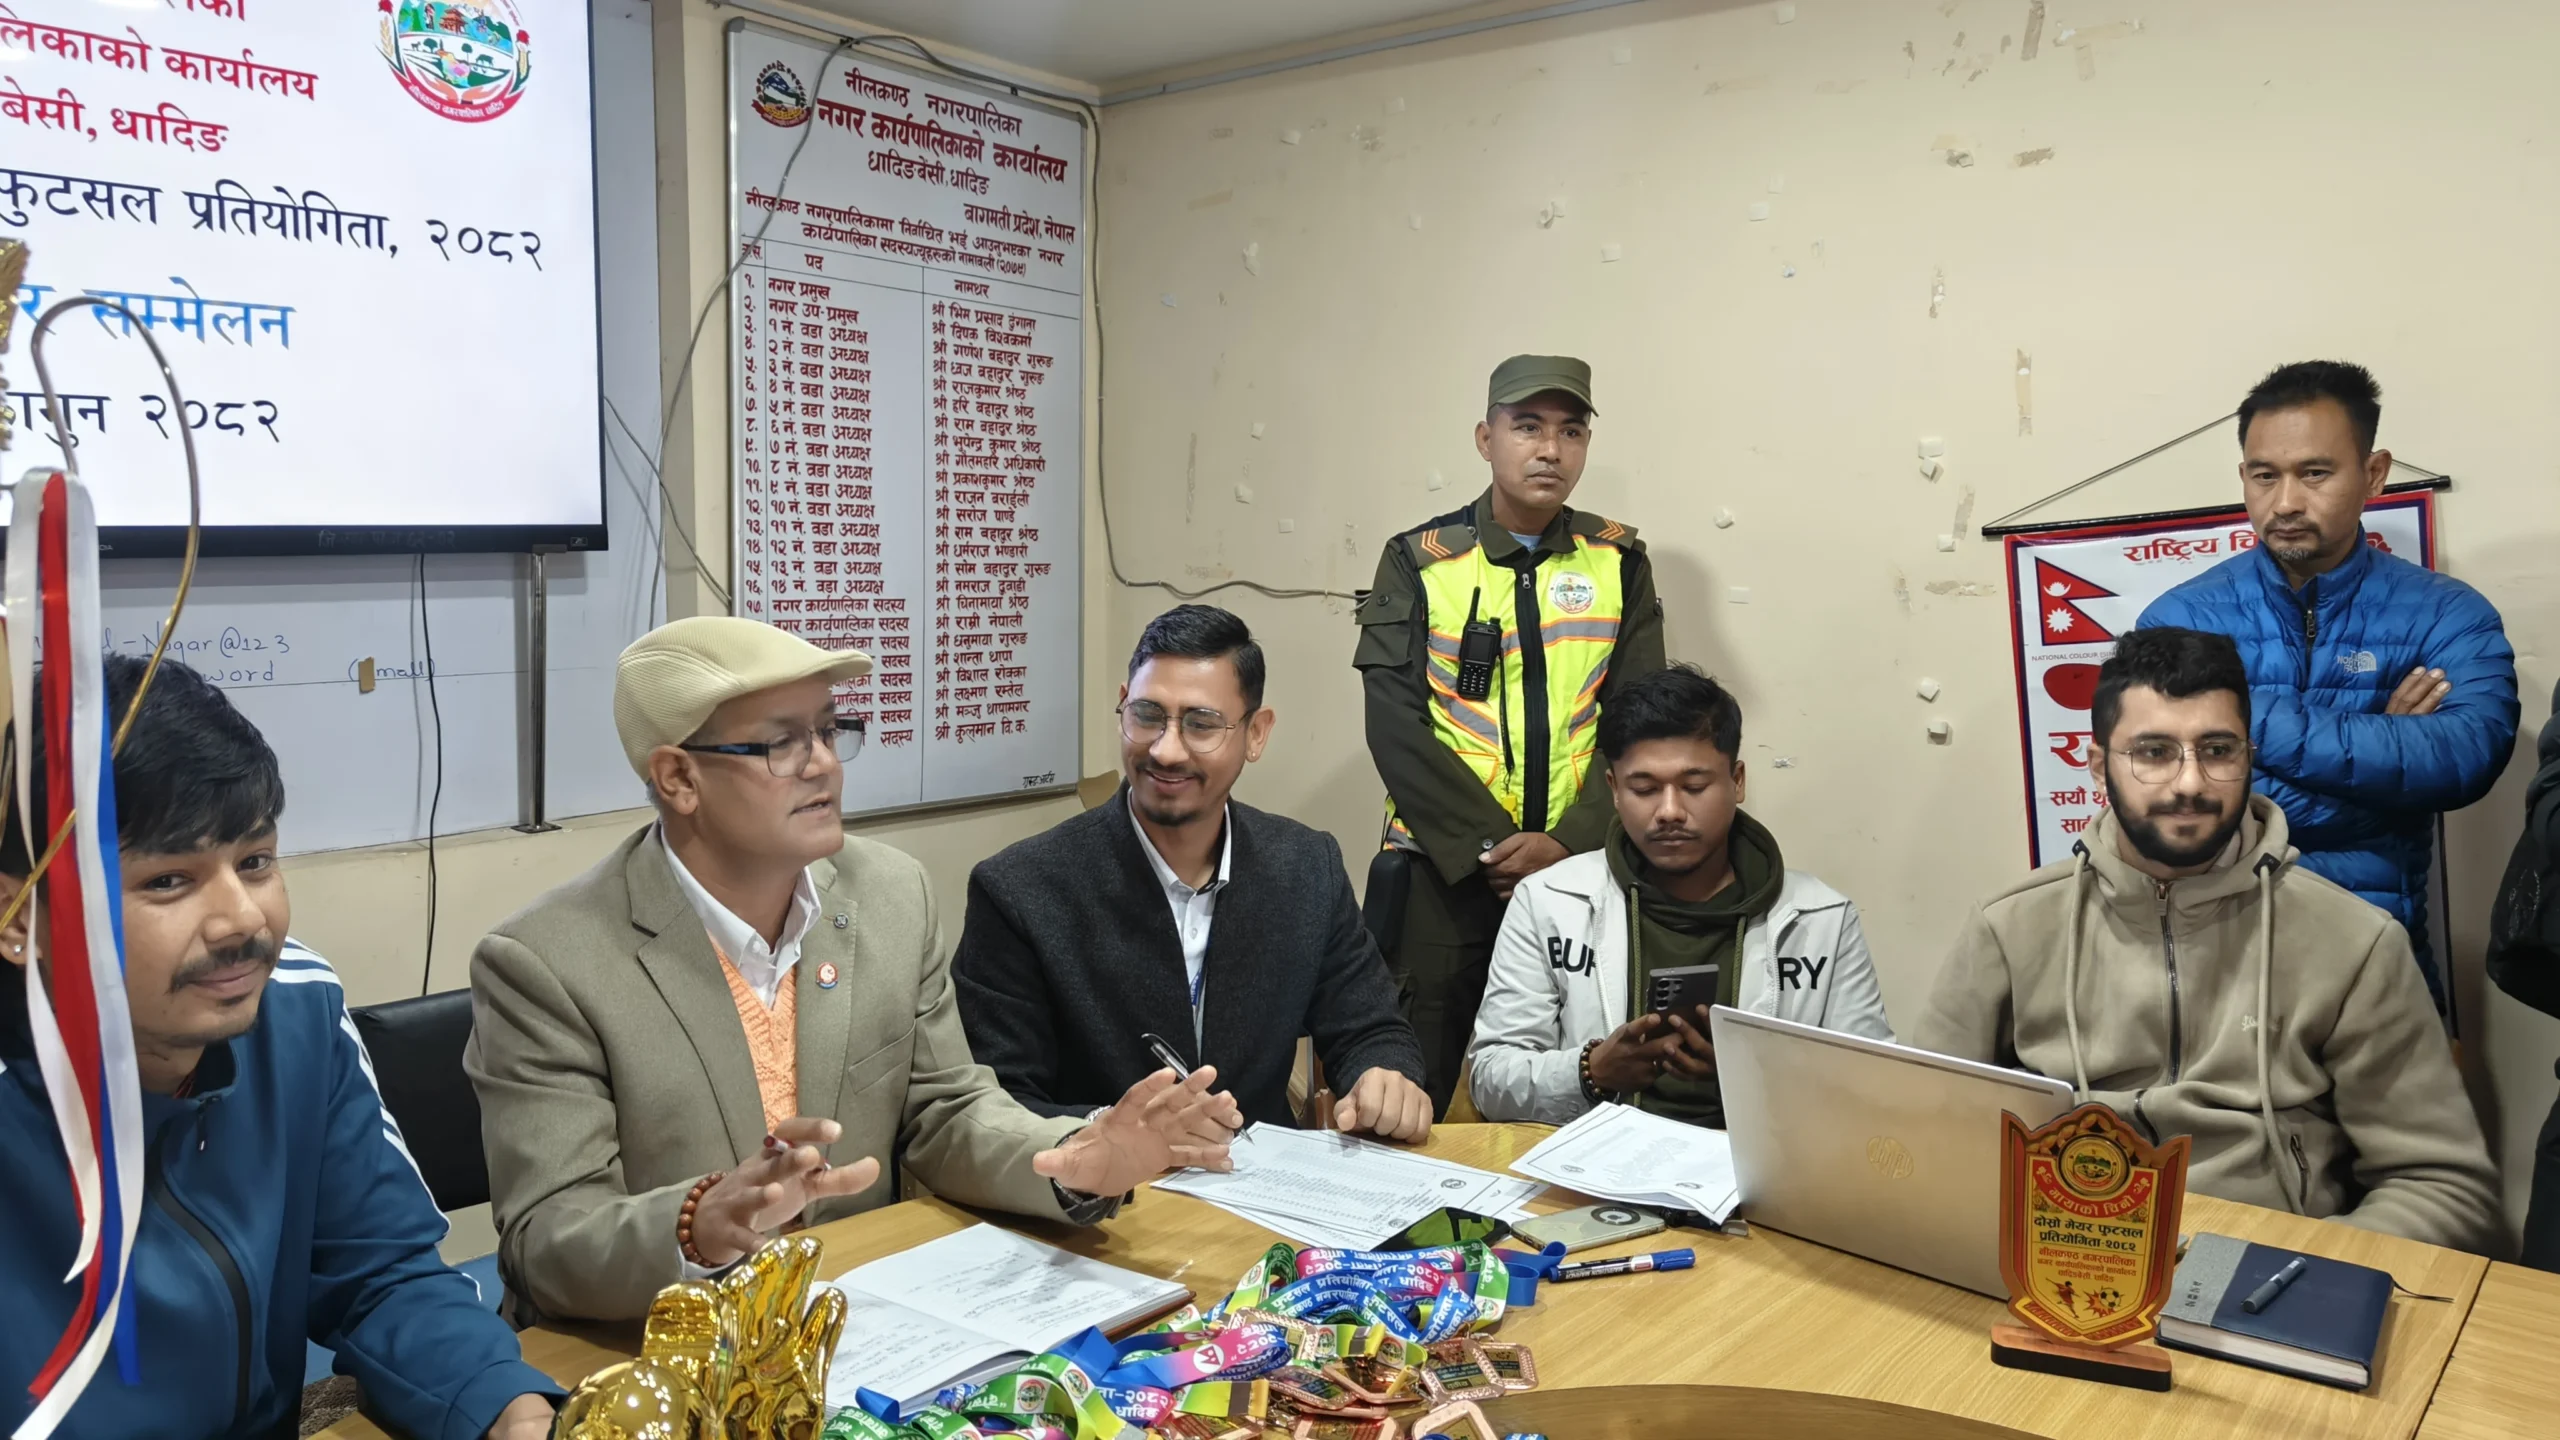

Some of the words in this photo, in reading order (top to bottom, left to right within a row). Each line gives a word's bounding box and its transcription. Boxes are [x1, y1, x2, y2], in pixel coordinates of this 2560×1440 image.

[160, 48, 318, 100] कार्यालय
[844, 67, 910, 107] नीलकण्ठ
[925, 93, 1022, 137] नगरपालिका
[110, 102, 228, 152] धादिङ
[817, 98, 866, 138] नगर
[871, 112, 985, 164] कार्यपालिकाको
[993, 144, 1068, 184] कार्यालय
[0, 168, 163, 227] फुटसल
[181, 178, 398, 258] प्रतियोगिता,
[426, 218, 542, 271] २०८२
[745, 187, 800, 215] नीलकण्ठ
[805, 203, 894, 232] नगरपालिकामा
[899, 217, 944, 244] निर्वाचित
[1038, 249, 1064, 267] नगर
[964, 203, 1011, 231] बागमती
[1044, 216, 1075, 243] नेपाल
[801, 222, 877, 249] कार्यपालिका
[805, 254, 823, 270] पद
[955, 279, 990, 298] नामथर
[768, 278, 795, 296] नगर
[799, 282, 830, 302] प्रमुख
[81, 276, 297, 350] सम्मेलन
[768, 299, 798, 316] नगर
[932, 301, 945, 317] श्री
[949, 302, 971, 318] भिम
[975, 310, 1003, 326] प्रसाद
[800, 322, 822, 339] वडा
[829, 327, 868, 344] अध्यक्ष
[932, 320, 946, 335] श्री
[933, 376, 946, 391] श्री
[952, 381, 1001, 398] राजकुमार
[139, 394, 279, 442] २०८२
[801, 403, 824, 418] वडा
[832, 406, 871, 423] अध्यक्ष
[934, 431, 948, 447] श्री
[989, 439, 1016, 452] कुमार
[936, 450, 949, 466] श्री
[1004, 455, 1045, 472] अधिकारी
[936, 469, 948, 484] श्री
[805, 482, 829, 497] वडा
[835, 484, 872, 500] अध्यक्ष
[937, 505, 949, 521] श्री
[956, 505, 987, 522] सरोज
[936, 541, 949, 557] श्री
[954, 541, 990, 558] धर्मराज
[995, 543, 1028, 558] भण्डारी
[2123, 538, 2219, 561] राष्ट्रिय
[814, 562, 837, 575] वडा
[844, 562, 882, 576] अध्यक्ष
[936, 577, 949, 592] श्री
[773, 600, 802, 613] नगर
[805, 595, 869, 612] कार्यपालिका
[873, 599, 905, 612] सदस्य
[805, 614, 875, 631] कार्यपालिका
[879, 618, 909, 631] सदस्य
[936, 614, 949, 630] श्री
[989, 611, 1023, 628] नेपाली
[935, 649, 949, 665] श्री
[954, 652, 983, 665] शान्ता
[989, 651, 1012, 662] थापा
[2032, 653, 2068, 661] NATIONAL
[2069, 652, 2098, 660] COLOUR
[202, 661, 274, 682] word
[936, 668, 950, 683] श्री
[936, 685, 949, 700] श्री
[936, 703, 949, 719] श्री
[880, 730, 913, 747] सदस्य
[935, 721, 950, 740] श्री
[2049, 1188, 2098, 1216] मायाको
[2103, 1195, 2134, 1214] चिनो
[2065, 1219, 2094, 1232] मेयर
[2099, 1224, 2143, 1238] फुटसल
[2082, 1253, 2136, 1267] नगरपालिका
